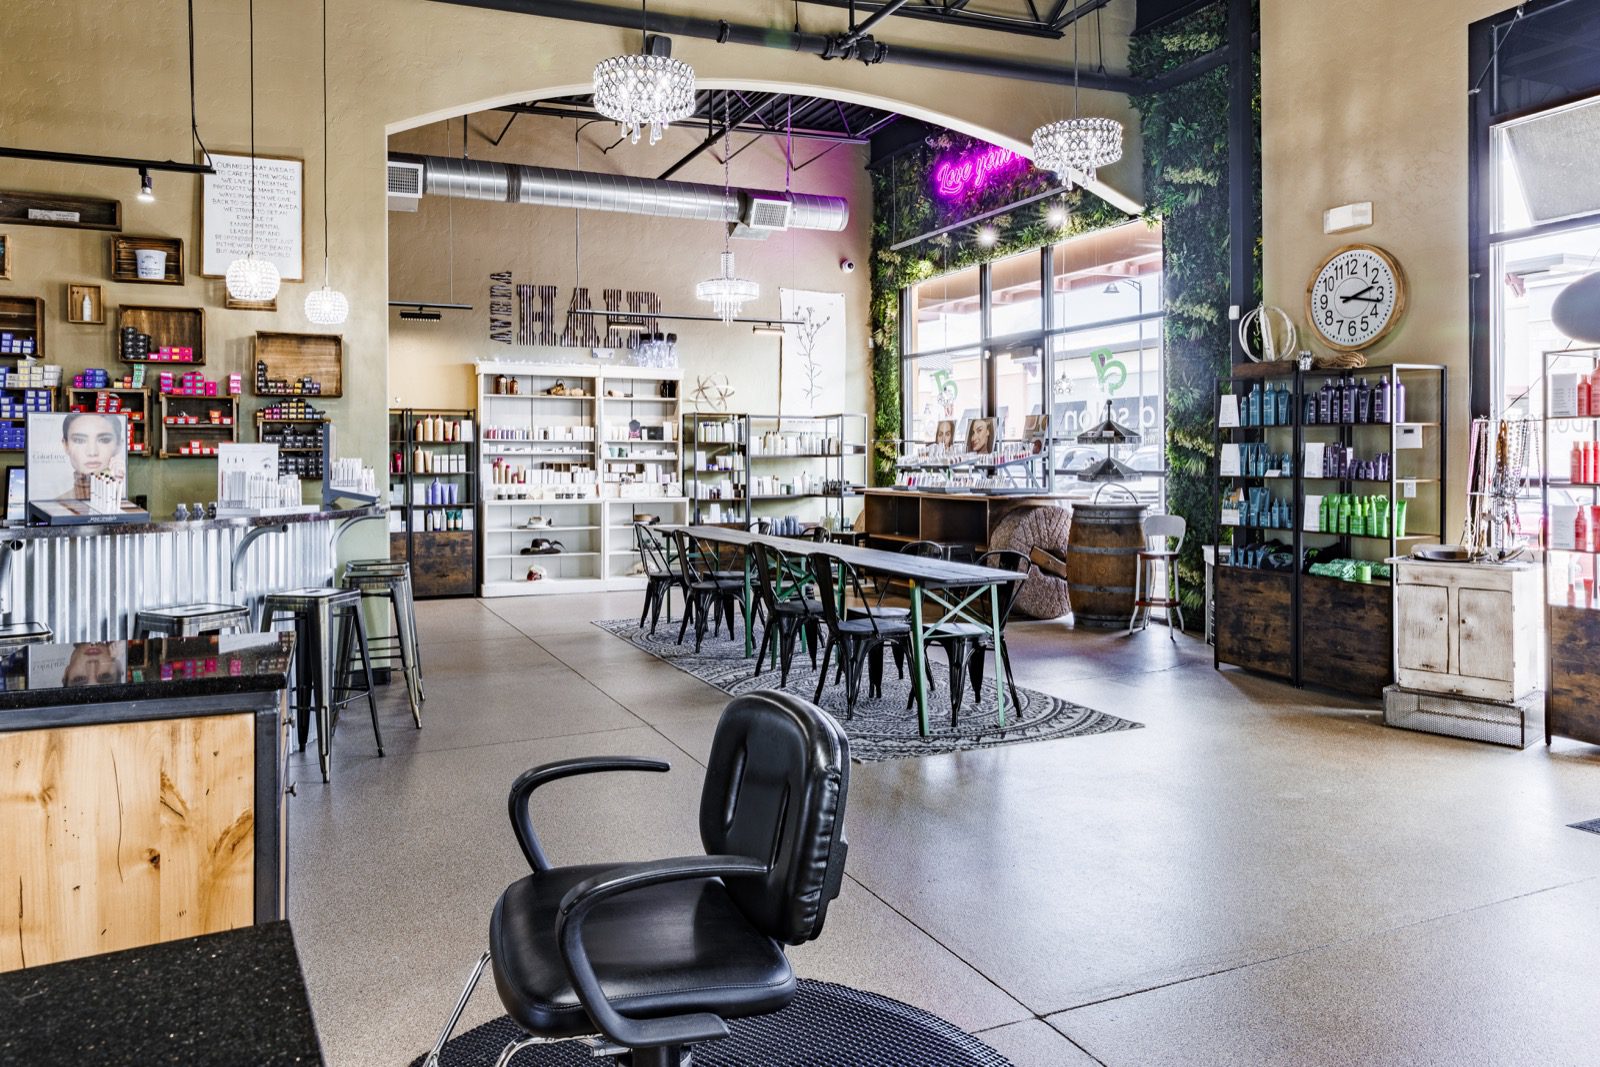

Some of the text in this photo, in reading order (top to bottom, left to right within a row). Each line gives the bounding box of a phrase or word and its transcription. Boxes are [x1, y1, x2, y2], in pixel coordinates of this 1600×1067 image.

[937, 161, 972, 194] Love
[1334, 264, 1343, 280] 11
[1345, 258, 1358, 276] 12
[1363, 261, 1368, 278] 1
[1371, 268, 1380, 284] 2
[1323, 276, 1335, 293] 10
[1320, 294, 1328, 310] 9
[1376, 286, 1384, 302] 3
[490, 270, 512, 344] AVEDA
[1370, 303, 1378, 318] 4
[516, 284, 661, 350] HAIR
[1324, 310, 1334, 326] 8
[1360, 316, 1369, 332] 5
[1336, 320, 1344, 336] 7
[1348, 320, 1357, 336] 6
